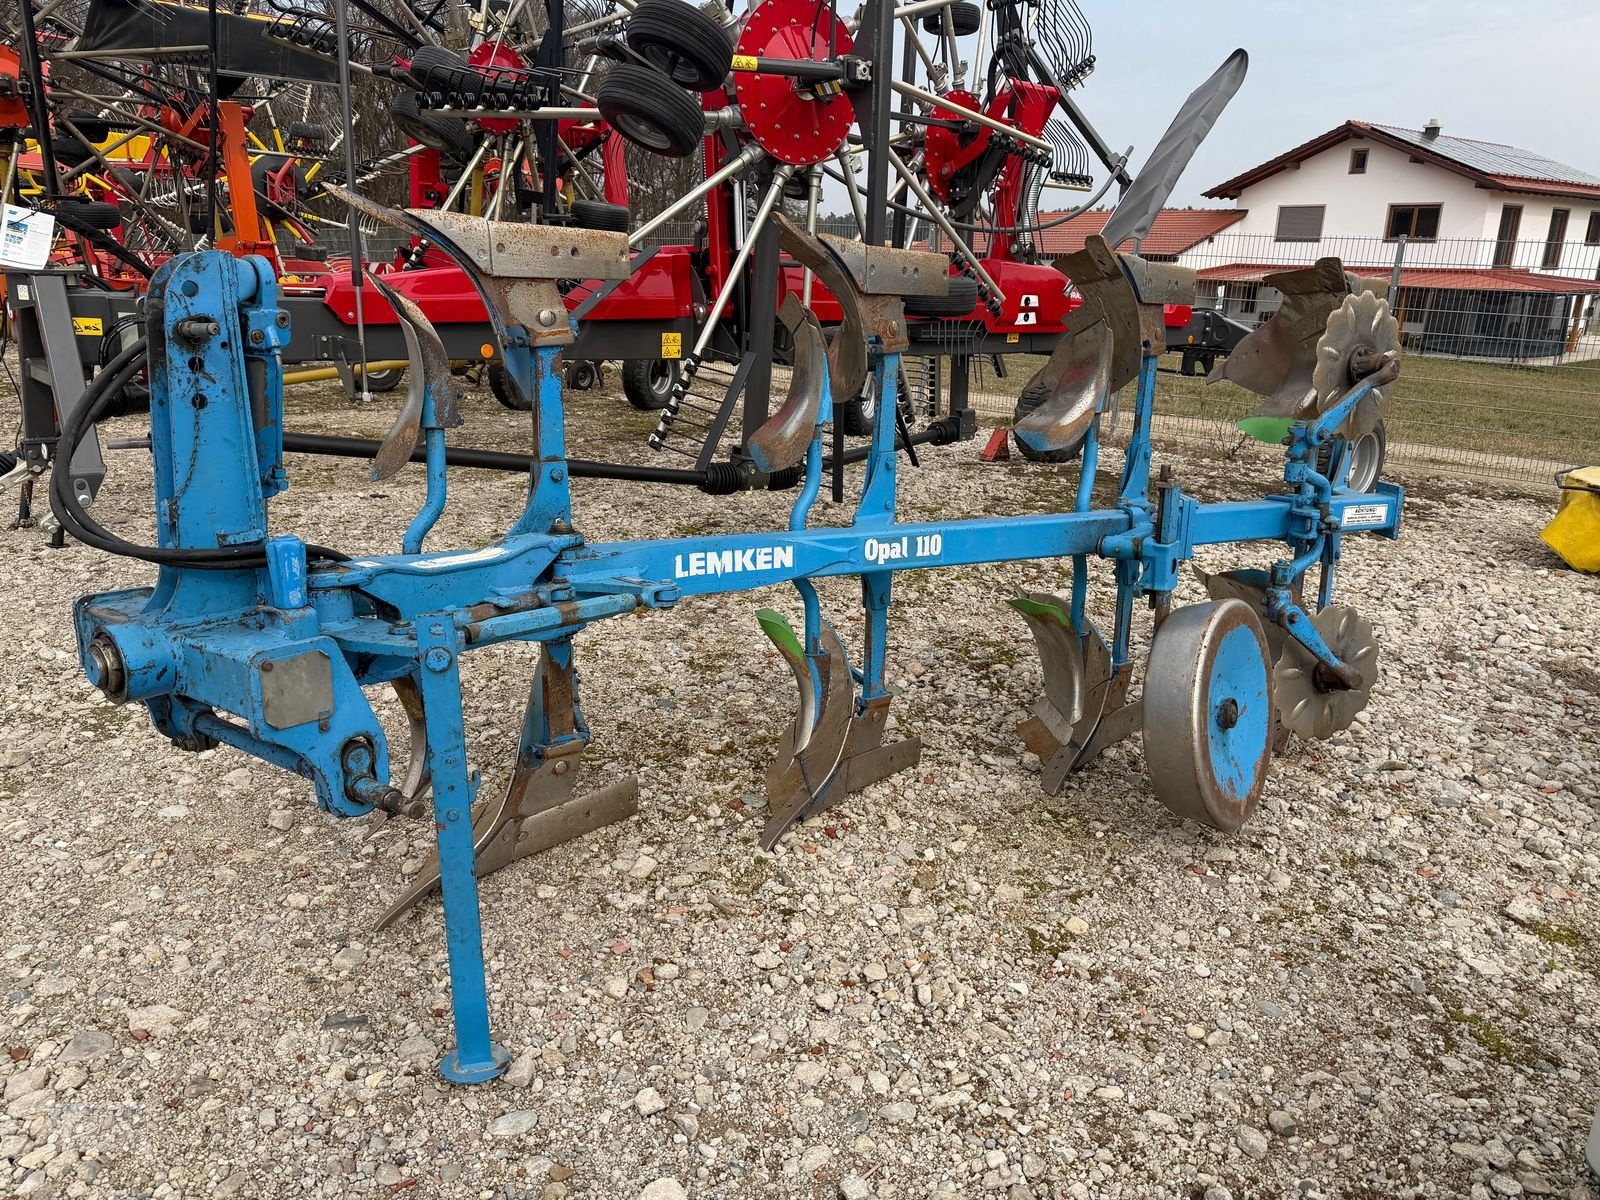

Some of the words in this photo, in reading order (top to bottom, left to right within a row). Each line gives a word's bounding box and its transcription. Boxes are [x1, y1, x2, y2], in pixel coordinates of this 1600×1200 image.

[675, 546, 794, 578] LEMKEN
[864, 537, 908, 564] Opal
[916, 534, 942, 556] 110
